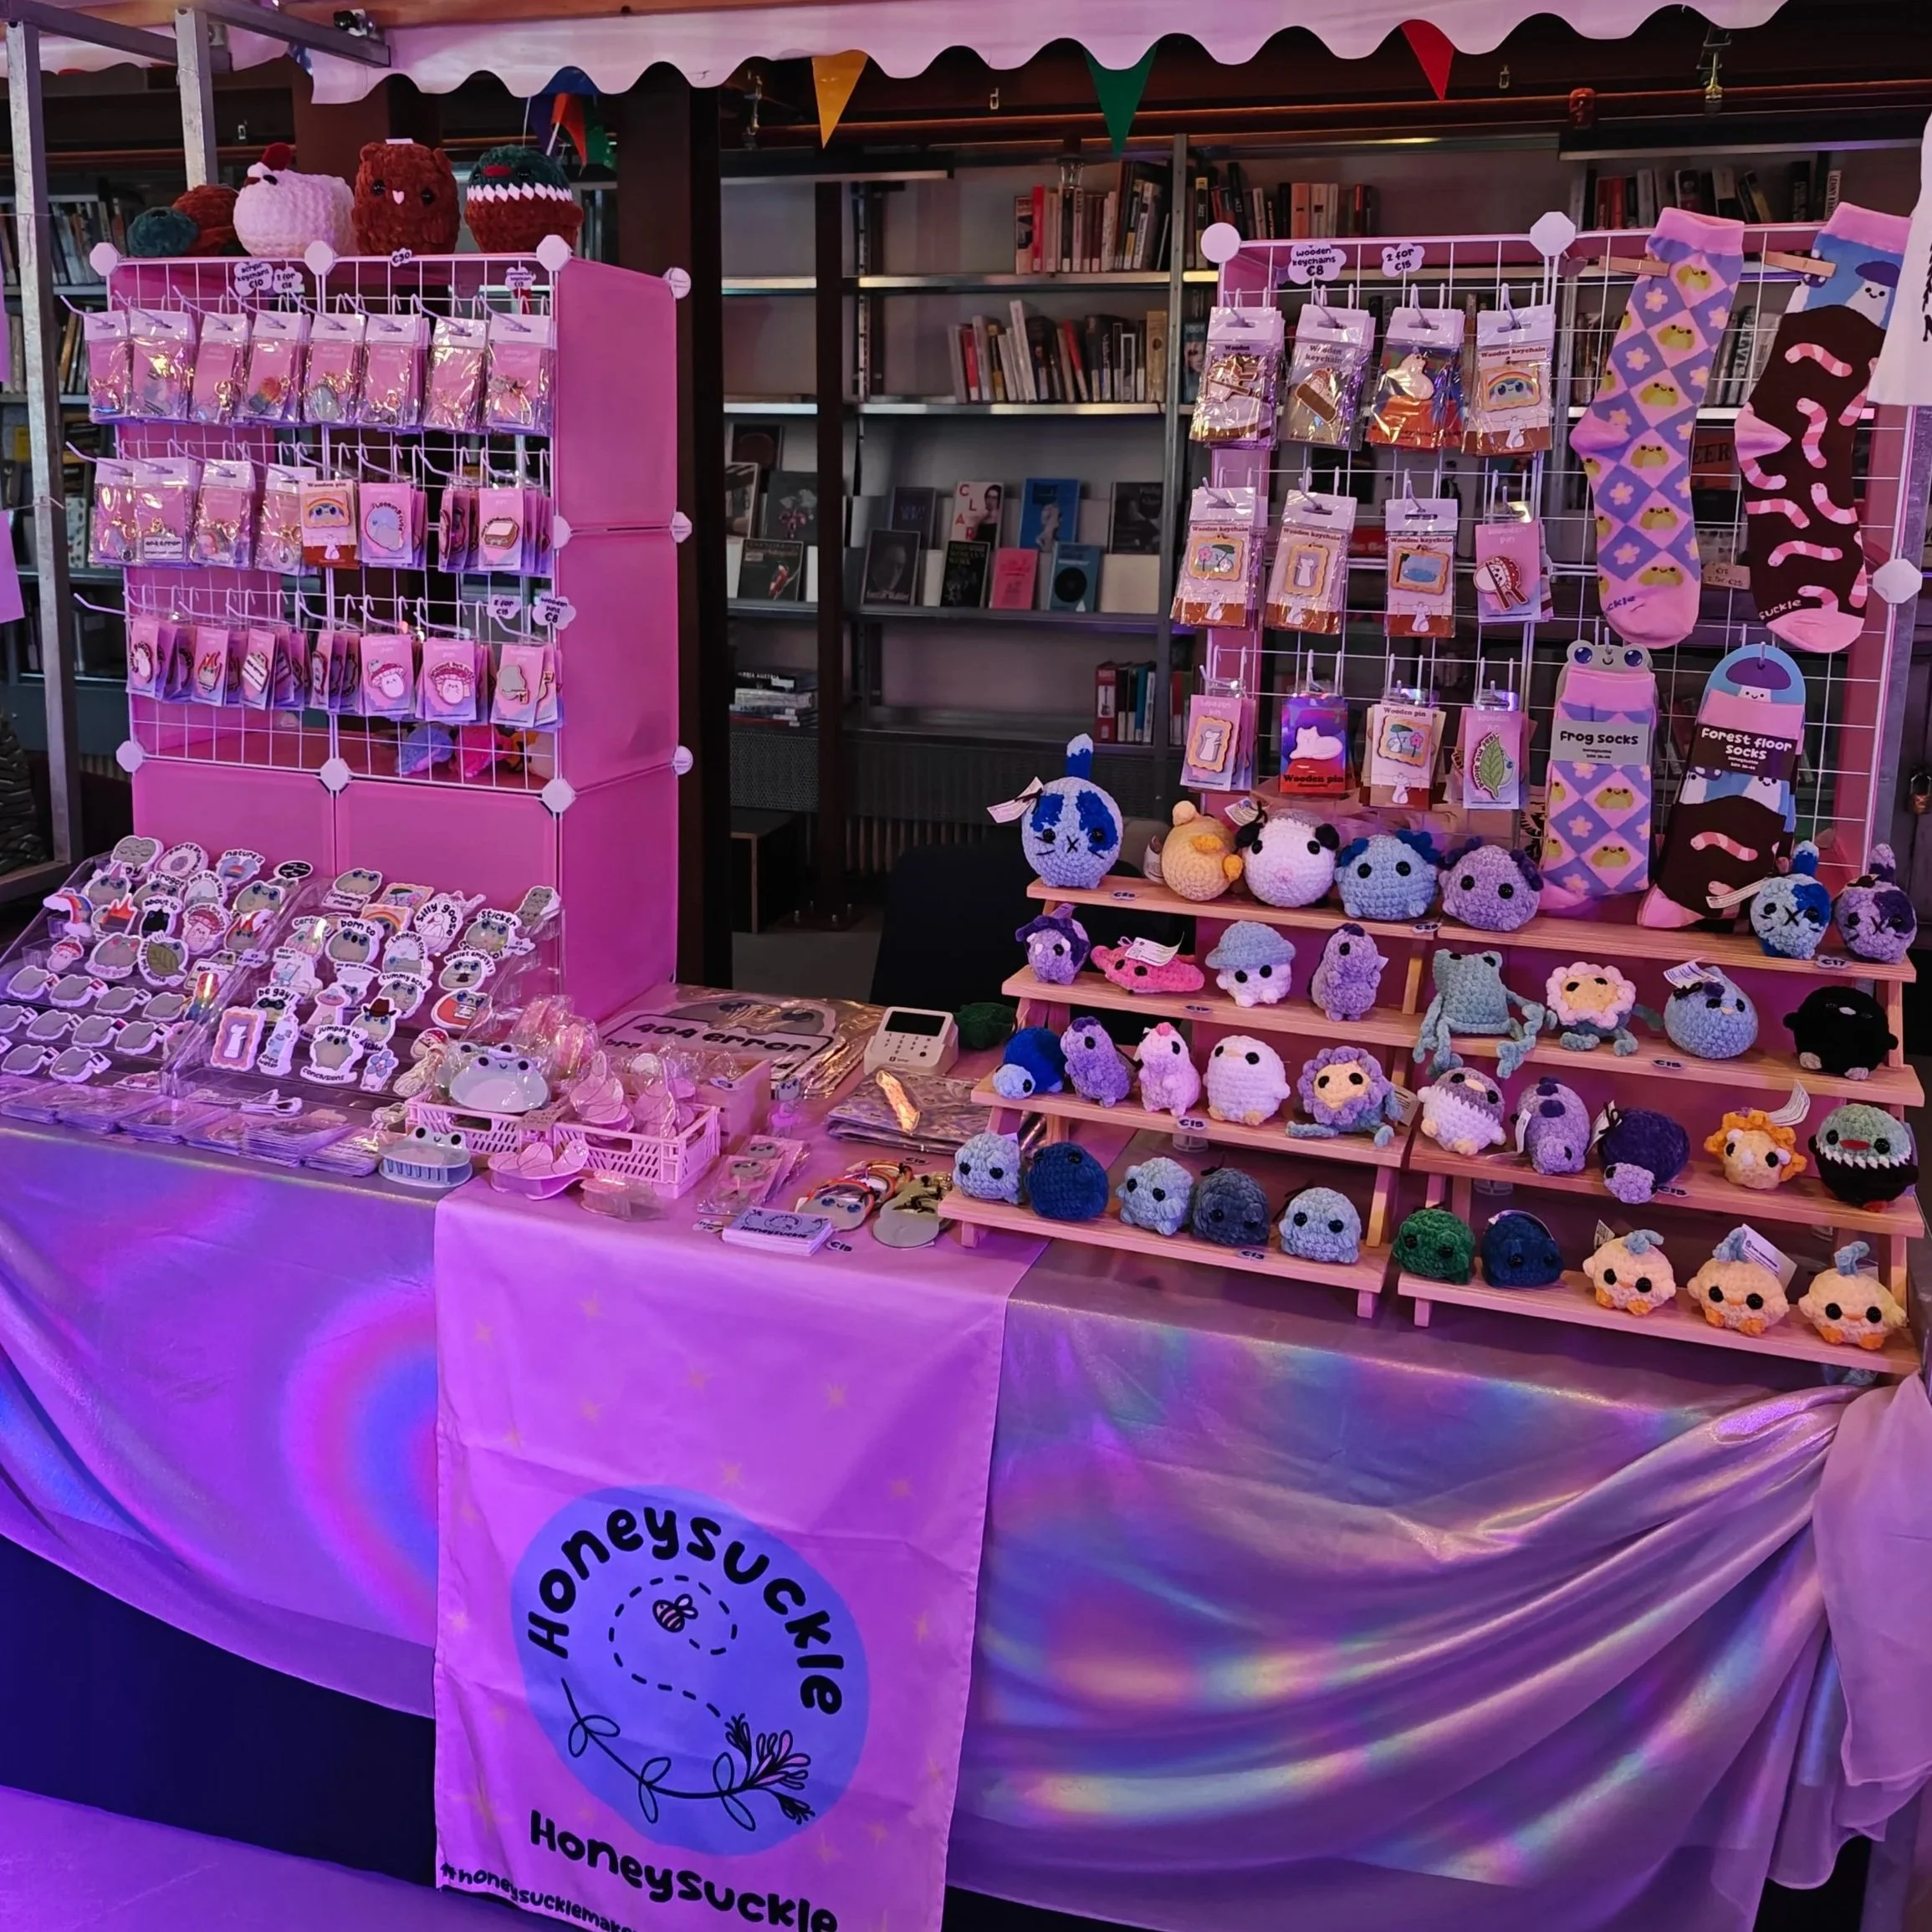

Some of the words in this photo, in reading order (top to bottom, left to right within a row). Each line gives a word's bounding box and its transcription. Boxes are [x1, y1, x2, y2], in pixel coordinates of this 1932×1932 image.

[1296, 248, 1331, 257] wooden
[1395, 248, 1414, 259] for
[1292, 256, 1337, 267] keychains
[1394, 260, 1412, 271] €15
[1306, 265, 1325, 276] €8
[1480, 350, 1510, 358] Wooden
[1511, 347, 1546, 355] keychain
[1283, 528, 1310, 536] Wooden
[540, 596, 569, 607] wooden
[544, 612, 559, 623] €8
[1383, 707, 1413, 716] Wooden
[1560, 730, 1594, 745] Frog
[1597, 734, 1638, 745] socks
[1701, 728, 1751, 745] Forest
[1754, 738, 1792, 752] floor
[1725, 744, 1767, 760] socks
[1284, 774, 1325, 783] Wooden
[1327, 774, 1344, 784] pin
[170, 902, 178, 910] to
[441, 904, 457, 937] goose
[481, 910, 517, 928] sticker
[340, 920, 365, 930] born
[366, 926, 376, 936] to
[381, 974, 410, 982] tummy
[258, 988, 270, 997] be
[319, 1025, 351, 1035] jumping
[351, 1030, 360, 1039] to
[633, 1023, 698, 1039] 404
[703, 1032, 811, 1052] error
[302, 1067, 345, 1081] conclusions
[527, 1506, 845, 1715] Honeysuckle
[529, 1809, 838, 1932] Honeysuckle
[440, 1862, 637, 1932] #honeysucklemak
